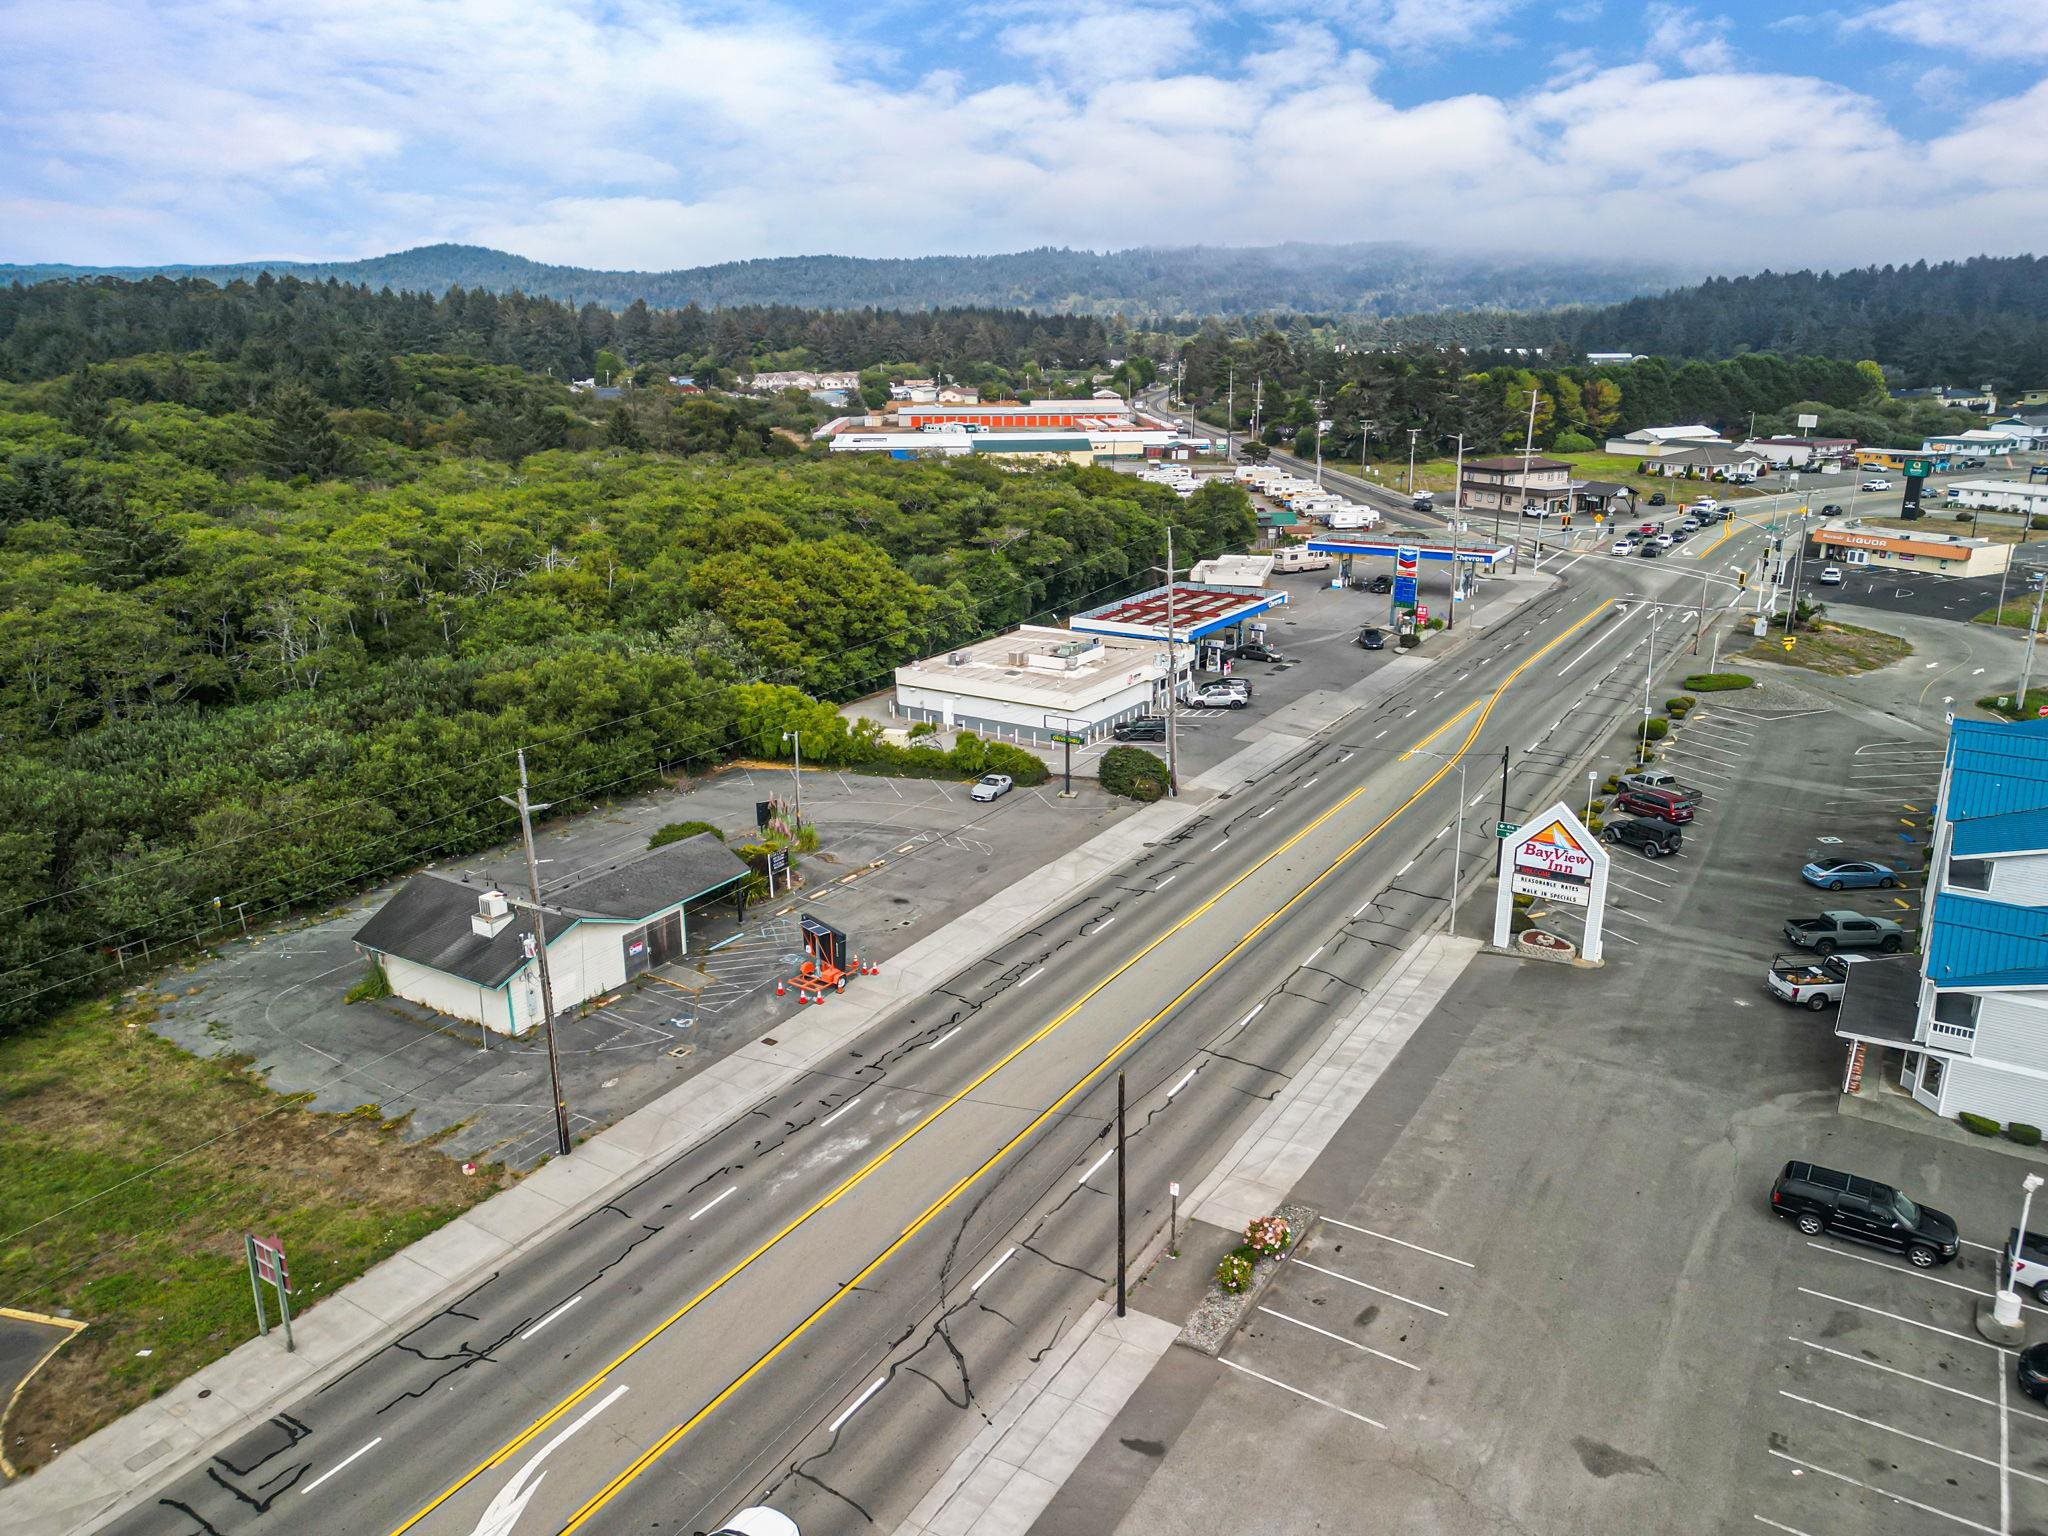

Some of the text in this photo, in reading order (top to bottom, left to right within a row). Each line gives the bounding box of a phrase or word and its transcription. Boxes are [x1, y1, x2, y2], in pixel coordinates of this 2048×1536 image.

[1846, 537, 1888, 547] LIQUOR
[1456, 555, 1485, 563] Chevron
[1523, 843, 1588, 865] BayView
[1547, 860, 1574, 874] Inn
[1521, 877, 1579, 892] REASONABLE RATES
[1522, 887, 1537, 895] WALK
[1550, 893, 1577, 903] SPECIALS
